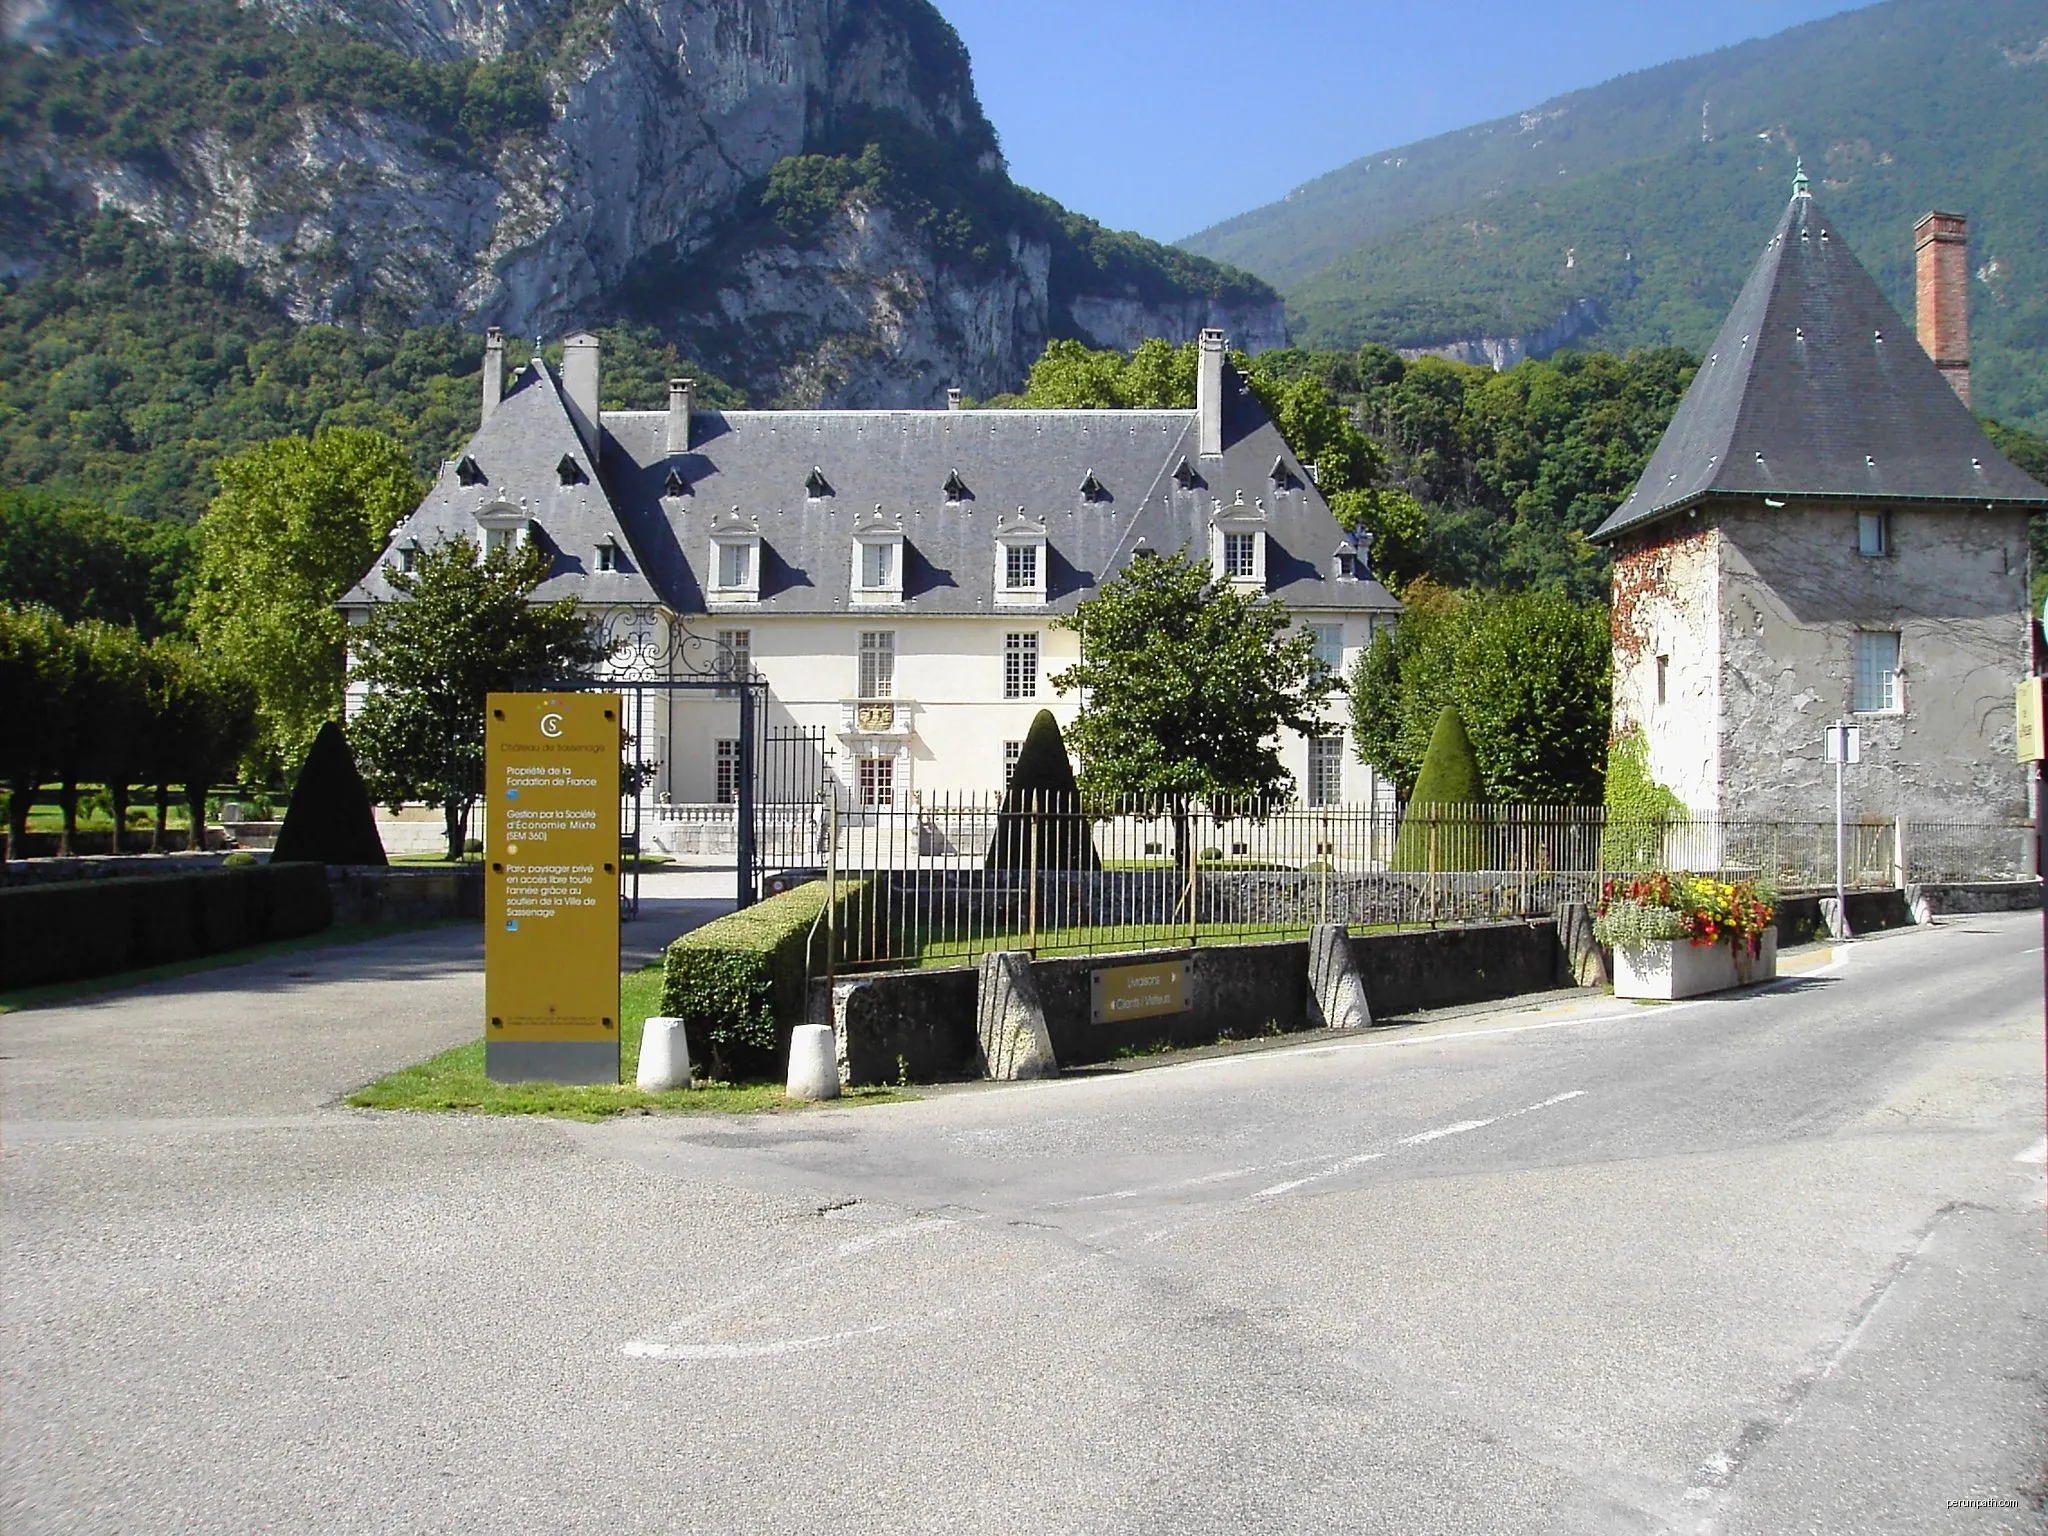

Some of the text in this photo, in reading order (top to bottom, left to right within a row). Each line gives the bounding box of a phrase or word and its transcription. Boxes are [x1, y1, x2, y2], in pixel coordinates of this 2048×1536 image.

[500, 743, 605, 753] Château de Sassenage
[506, 766, 572, 776] Propriété de la
[506, 777, 597, 786] Fondation de France
[506, 809, 596, 819] Gestion par la Société
[506, 820, 596, 829] d'Économie Mixte
[506, 832, 547, 841] (SEM 360)
[506, 864, 594, 875] Parc paysager privé
[520, 876, 547, 884] accès
[549, 876, 567, 884] libre
[569, 876, 592, 884] toute
[506, 886, 582, 896] l'année grâce au
[506, 897, 596, 906] soutien de la Ville de
[506, 907, 555, 918] Sassenage
